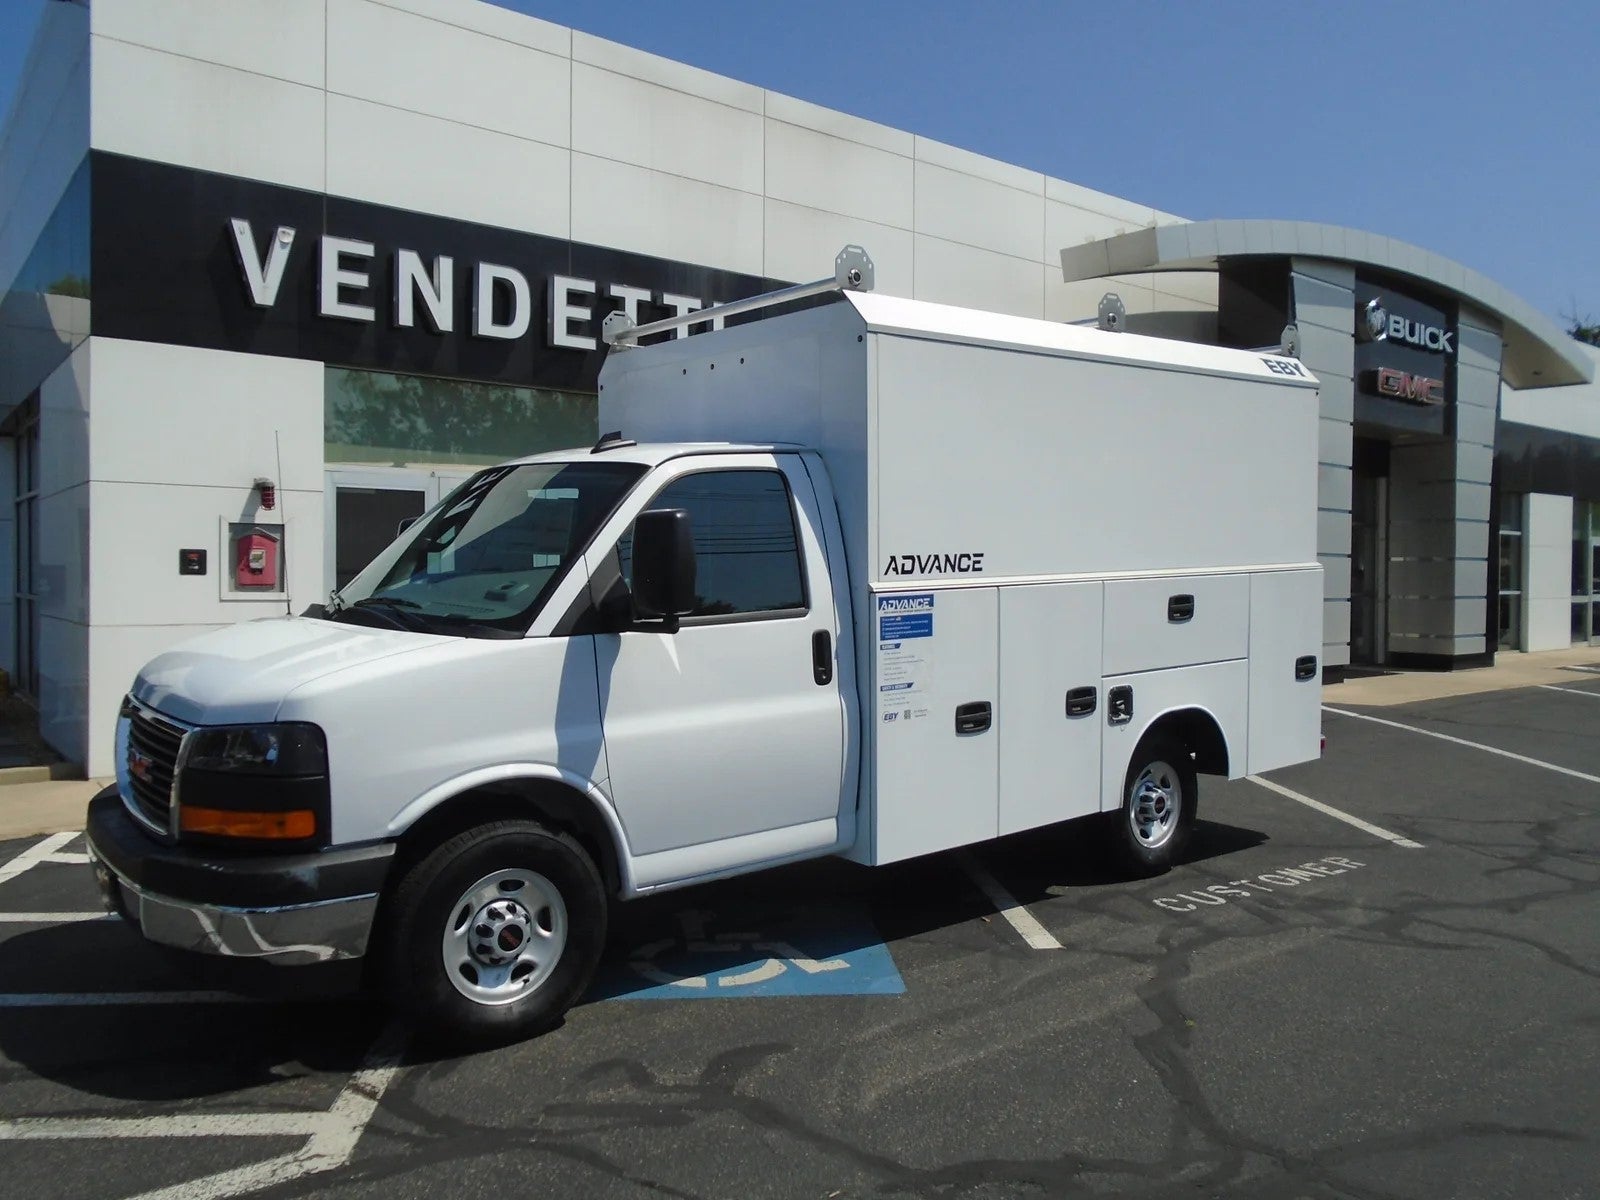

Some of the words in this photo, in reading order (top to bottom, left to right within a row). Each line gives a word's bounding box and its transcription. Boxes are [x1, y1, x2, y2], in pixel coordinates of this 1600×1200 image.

[1388, 314, 1454, 353] BUICK
[1260, 357, 1307, 378] EBY
[1377, 366, 1444, 405] GMC
[883, 553, 984, 576] ADVANCE
[880, 597, 931, 611] ADVANCE
[1152, 856, 1367, 912] CUSTOMER
